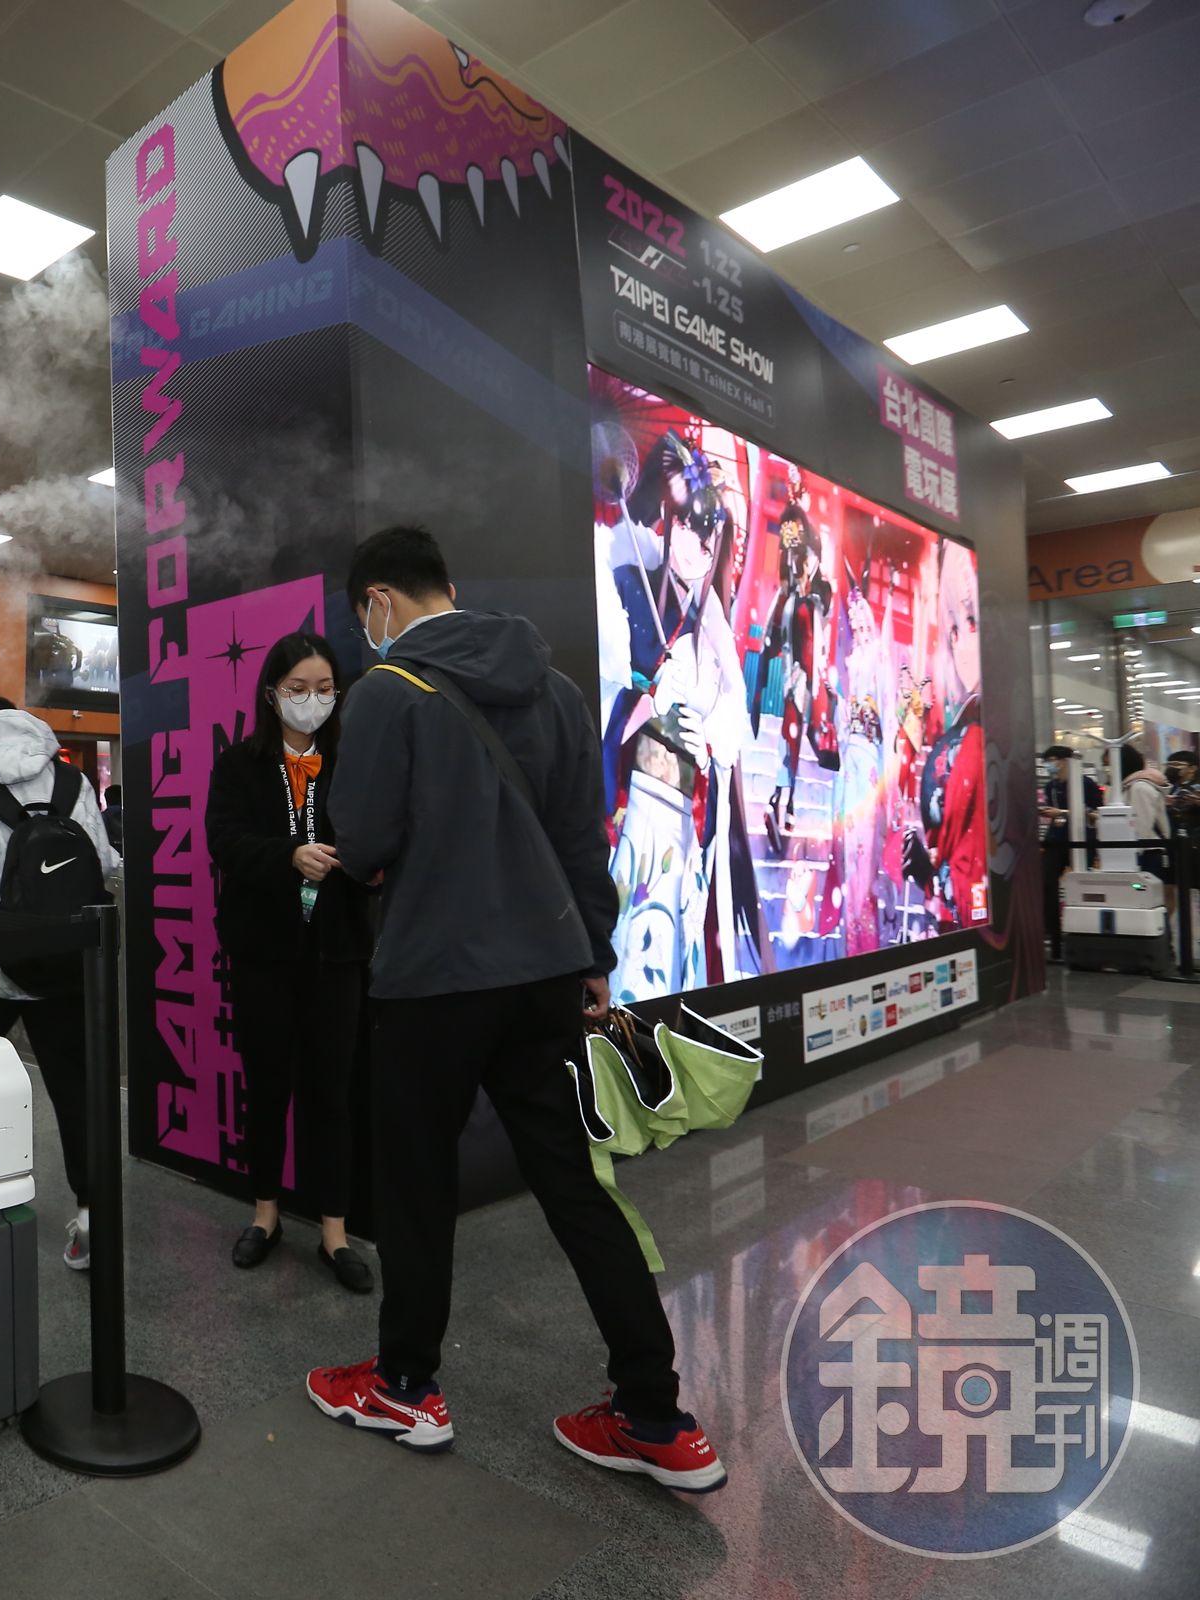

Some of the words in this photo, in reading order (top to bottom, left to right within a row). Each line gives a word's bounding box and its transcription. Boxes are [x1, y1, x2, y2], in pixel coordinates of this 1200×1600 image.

[603, 174, 686, 258] 2022
[700, 239, 742, 288] 1.22
[610, 264, 670, 324] TAIPEI
[674, 304, 727, 356] GAME
[730, 337, 774, 384] SHOW
[135, 123, 190, 684] FORWARD
[703, 367, 741, 401] TaiNEX
[744, 391, 765, 413] Hall
[766, 404, 773, 418] 1
[883, 375, 955, 457] 台北國際
[904, 444, 959, 517] 電玩展
[1028, 560, 1134, 593] Area
[306, 781, 316, 807] TAIPEI
[306, 807, 315, 832] GAME
